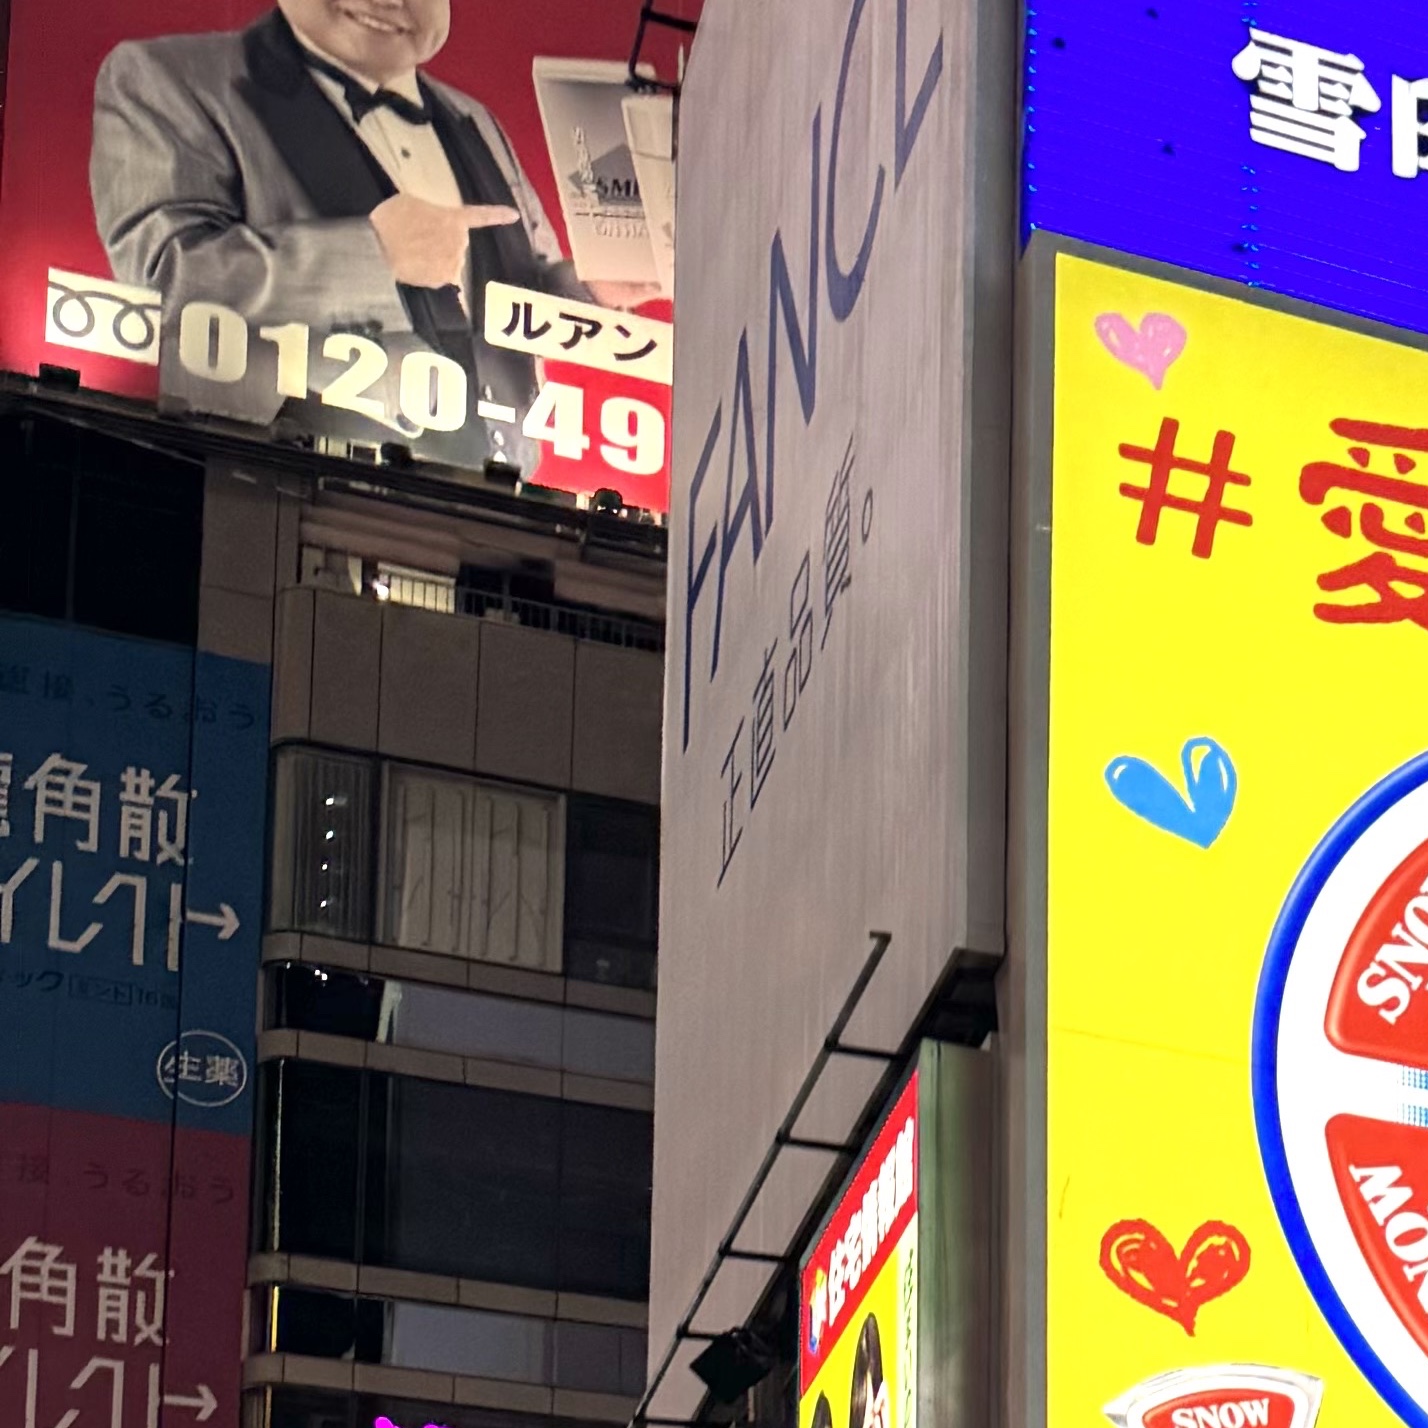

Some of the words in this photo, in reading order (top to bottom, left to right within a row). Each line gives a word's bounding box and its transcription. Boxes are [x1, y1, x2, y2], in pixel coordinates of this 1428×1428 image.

[503, 301, 658, 362] ルアン
[178, 303, 666, 476] 0120-49
[717, 432, 874, 890] 正直品質。
[0, 752, 198, 866] 角散
[0, 1236, 176, 1347] 角散
